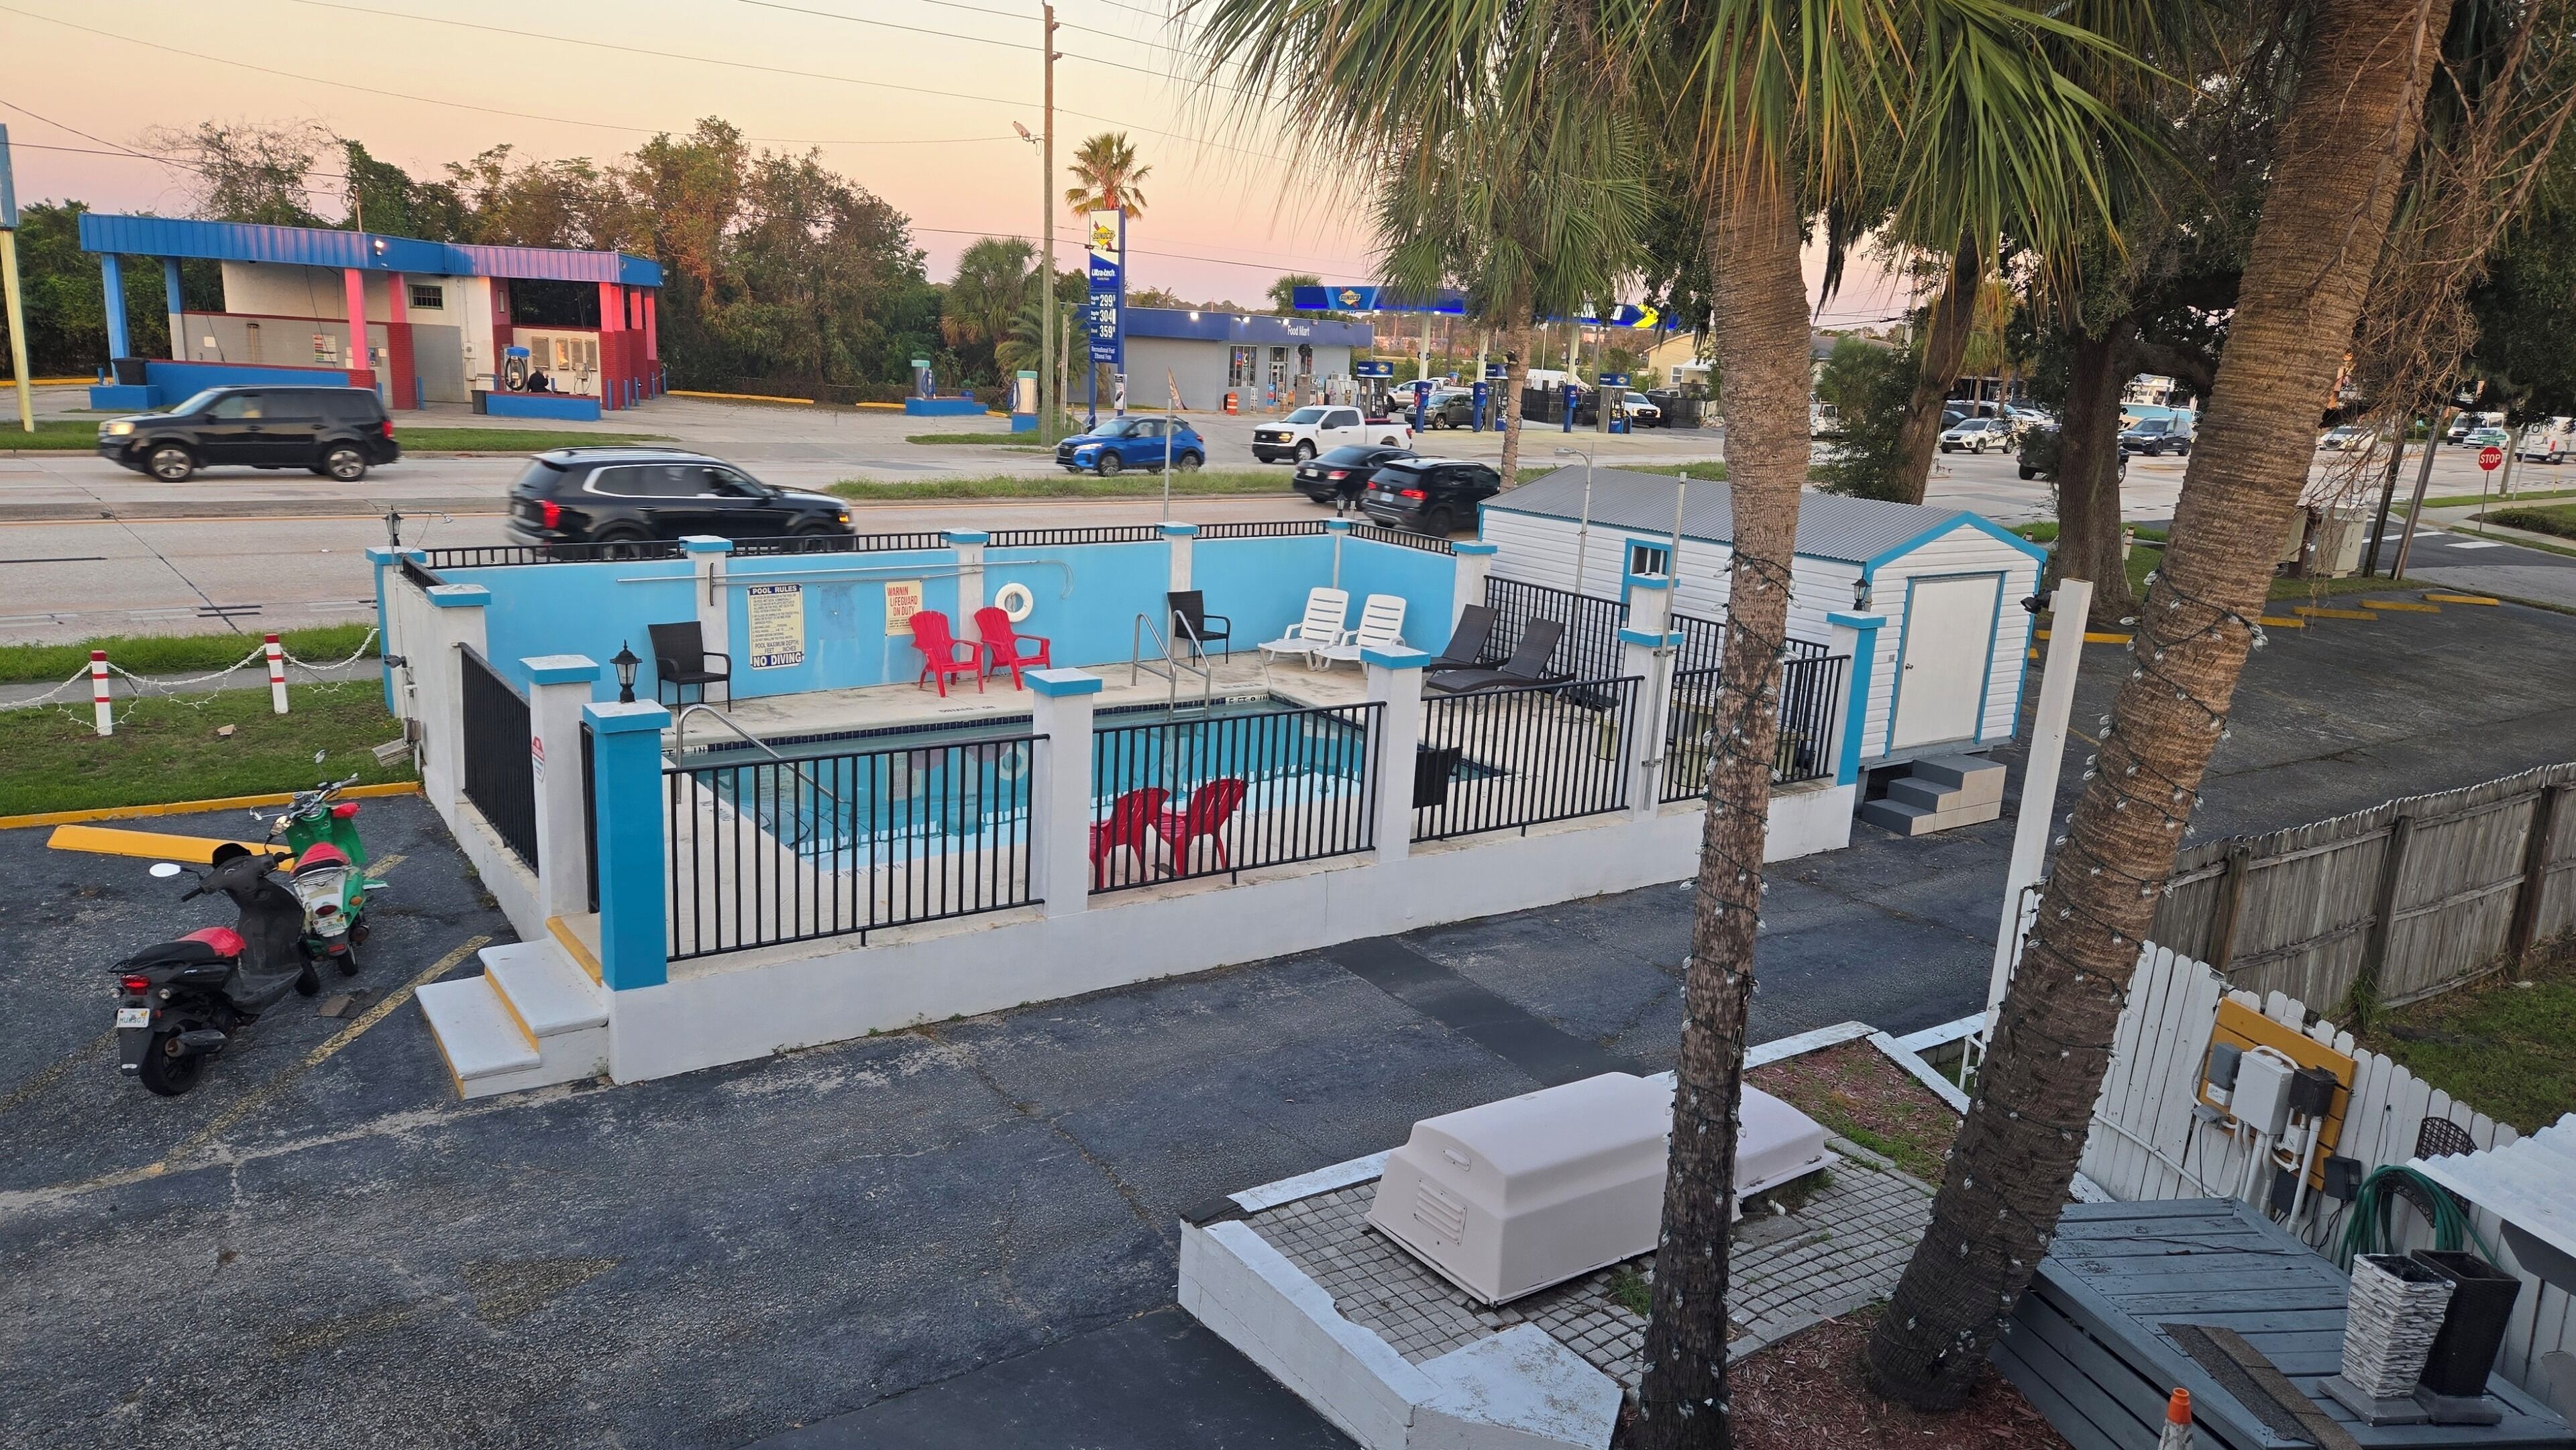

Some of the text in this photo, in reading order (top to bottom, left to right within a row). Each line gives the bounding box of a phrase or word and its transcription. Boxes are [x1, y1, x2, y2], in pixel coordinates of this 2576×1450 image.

[1288, 325, 1309, 336] Food Mart
[2479, 454, 2501, 464] STOP
[774, 585, 797, 593] RULES
[890, 596, 918, 607] LIFEGUARD
[893, 606, 915, 616] ON DUTY
[753, 652, 801, 667] NO DIVING
